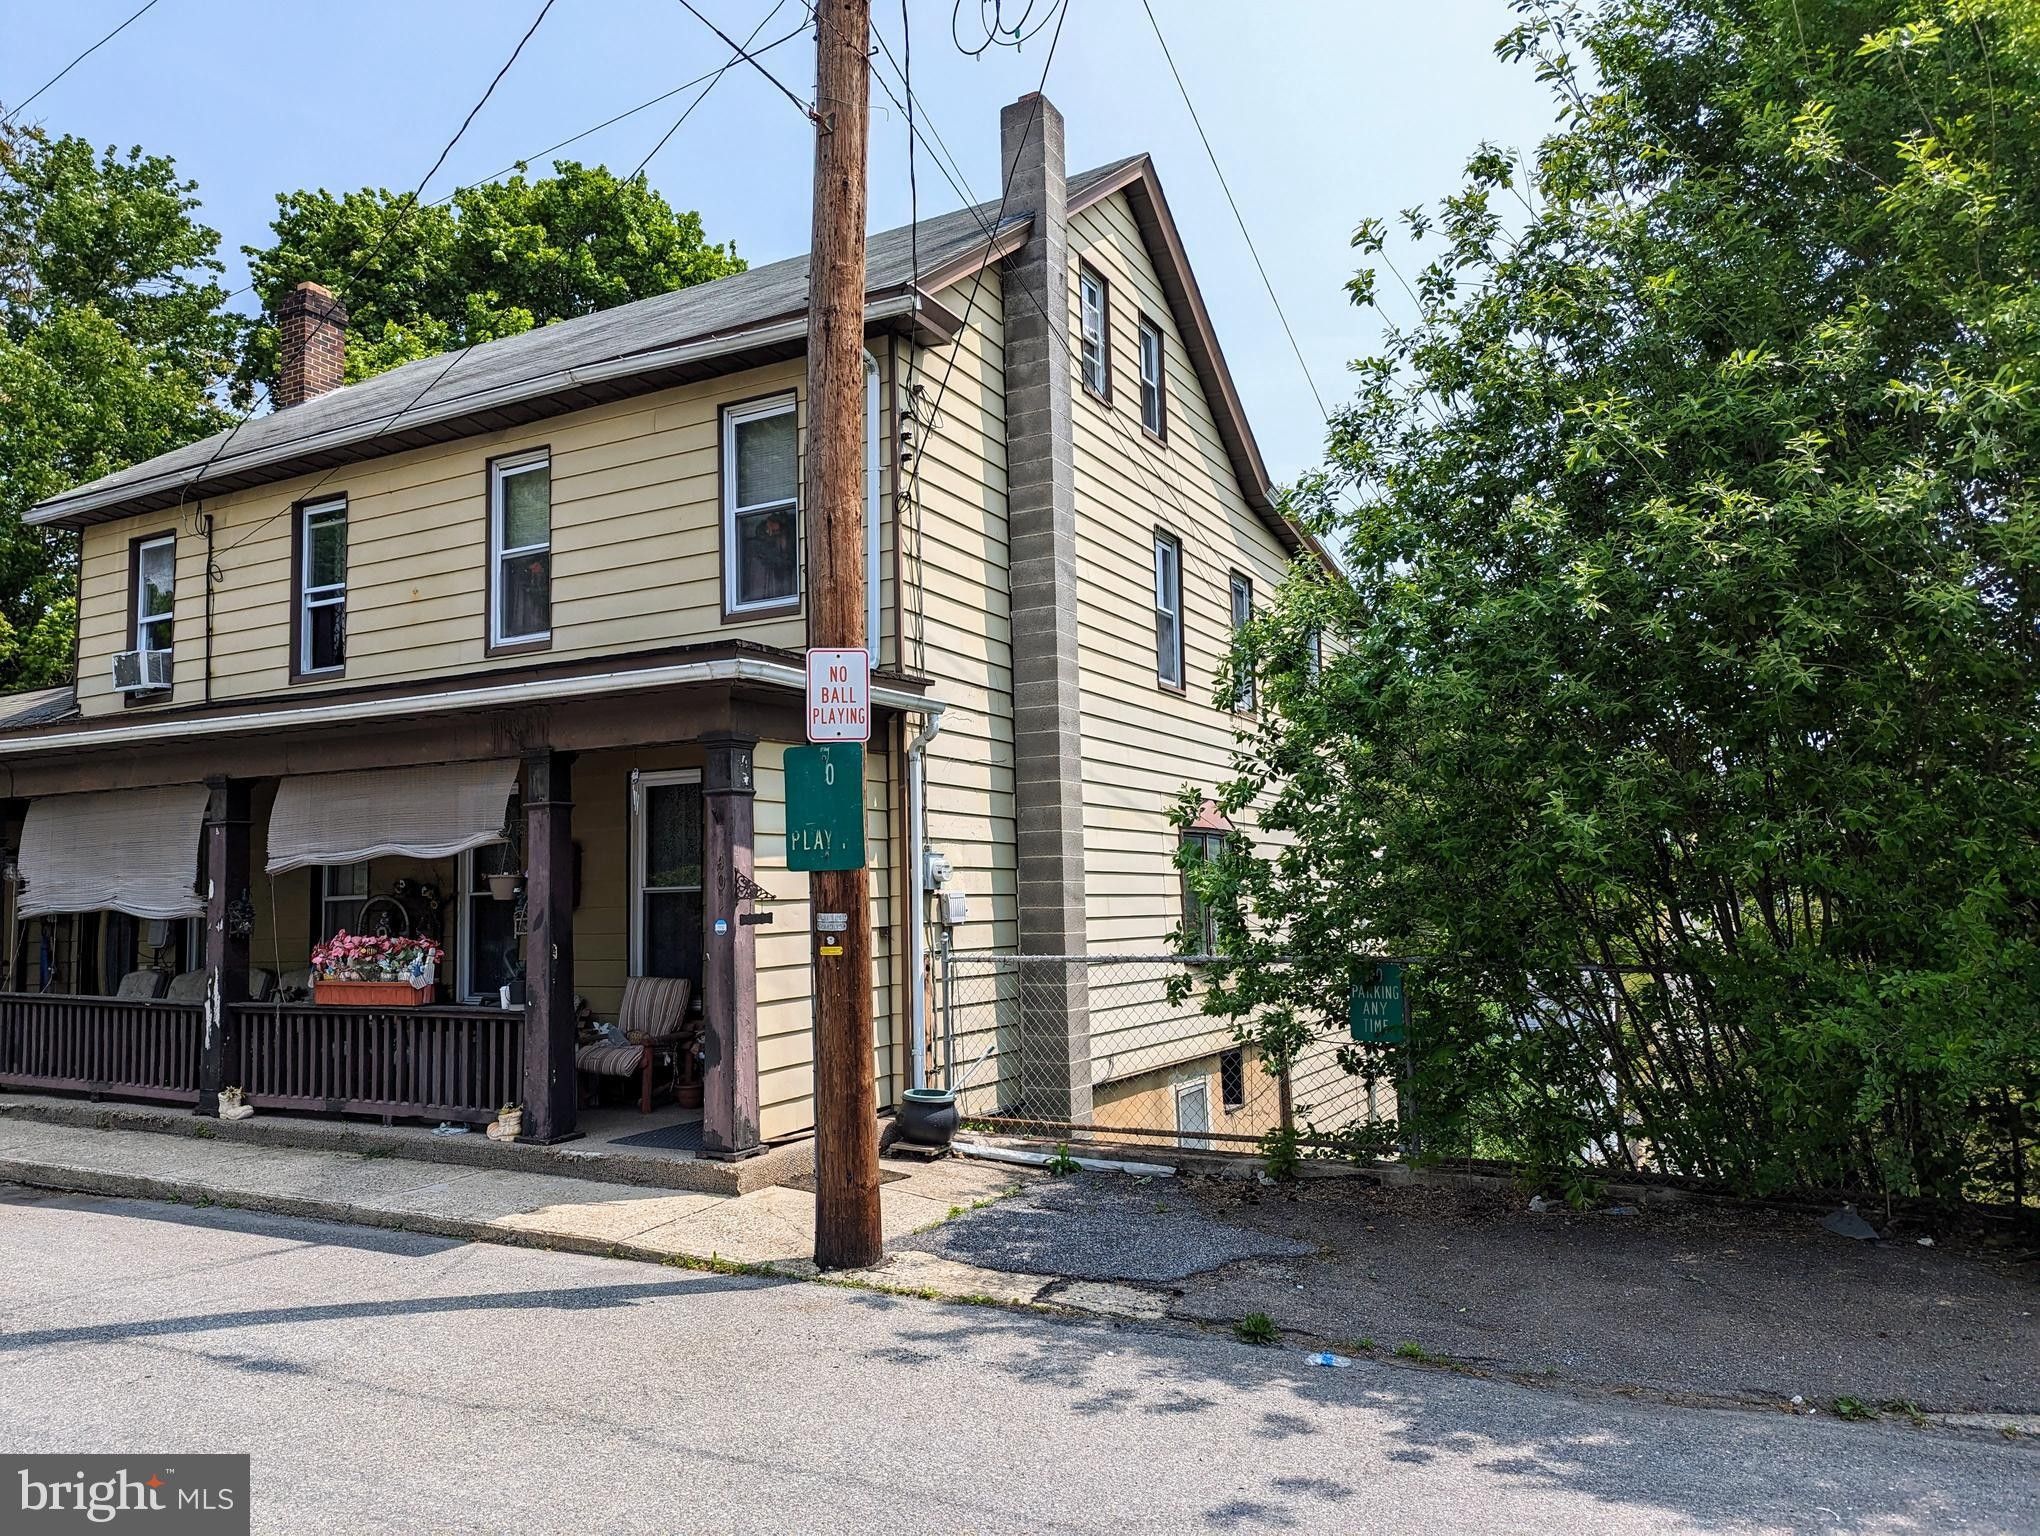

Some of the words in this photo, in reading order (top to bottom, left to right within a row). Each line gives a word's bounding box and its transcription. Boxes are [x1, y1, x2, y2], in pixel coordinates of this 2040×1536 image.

[830, 665, 847, 682] NO
[821, 687, 857, 703] BALL
[813, 707, 865, 724] PLAYING
[1363, 1001, 1388, 1015] ANY
